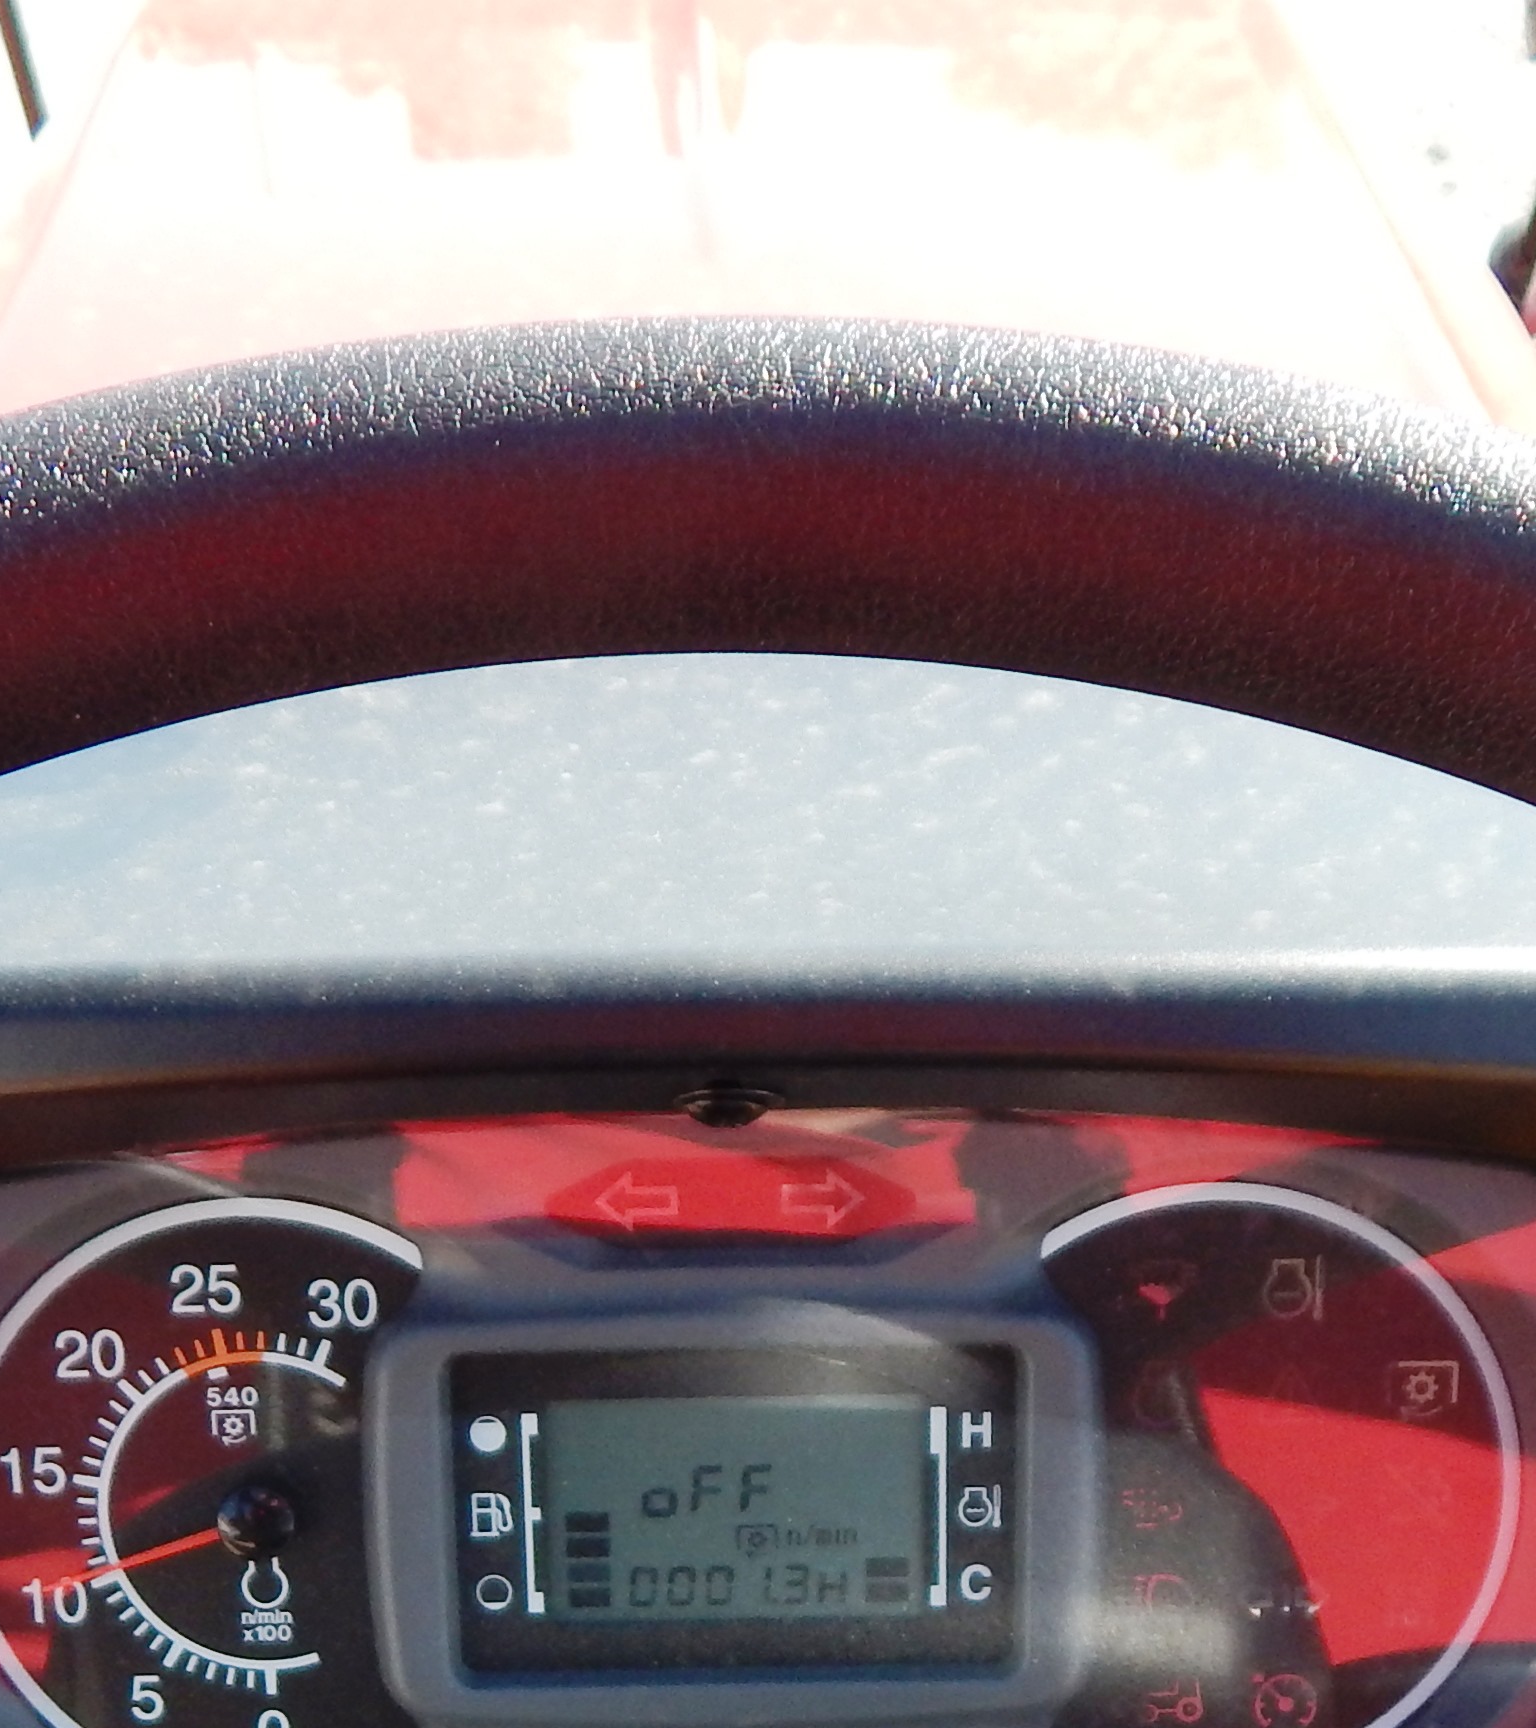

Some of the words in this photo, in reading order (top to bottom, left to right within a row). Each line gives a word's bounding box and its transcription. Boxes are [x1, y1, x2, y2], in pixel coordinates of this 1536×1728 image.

[170, 1263, 242, 1315] 25
[307, 1278, 378, 1329] 30
[55, 1328, 126, 1379] 20
[206, 1386, 259, 1408] 540
[960, 1411, 992, 1449] H
[0, 1446, 68, 1496] 15
[21, 1576, 88, 1624] 10
[959, 1563, 993, 1602] C
[240, 1608, 294, 1625] n/min
[131, 1674, 165, 1721] 5
